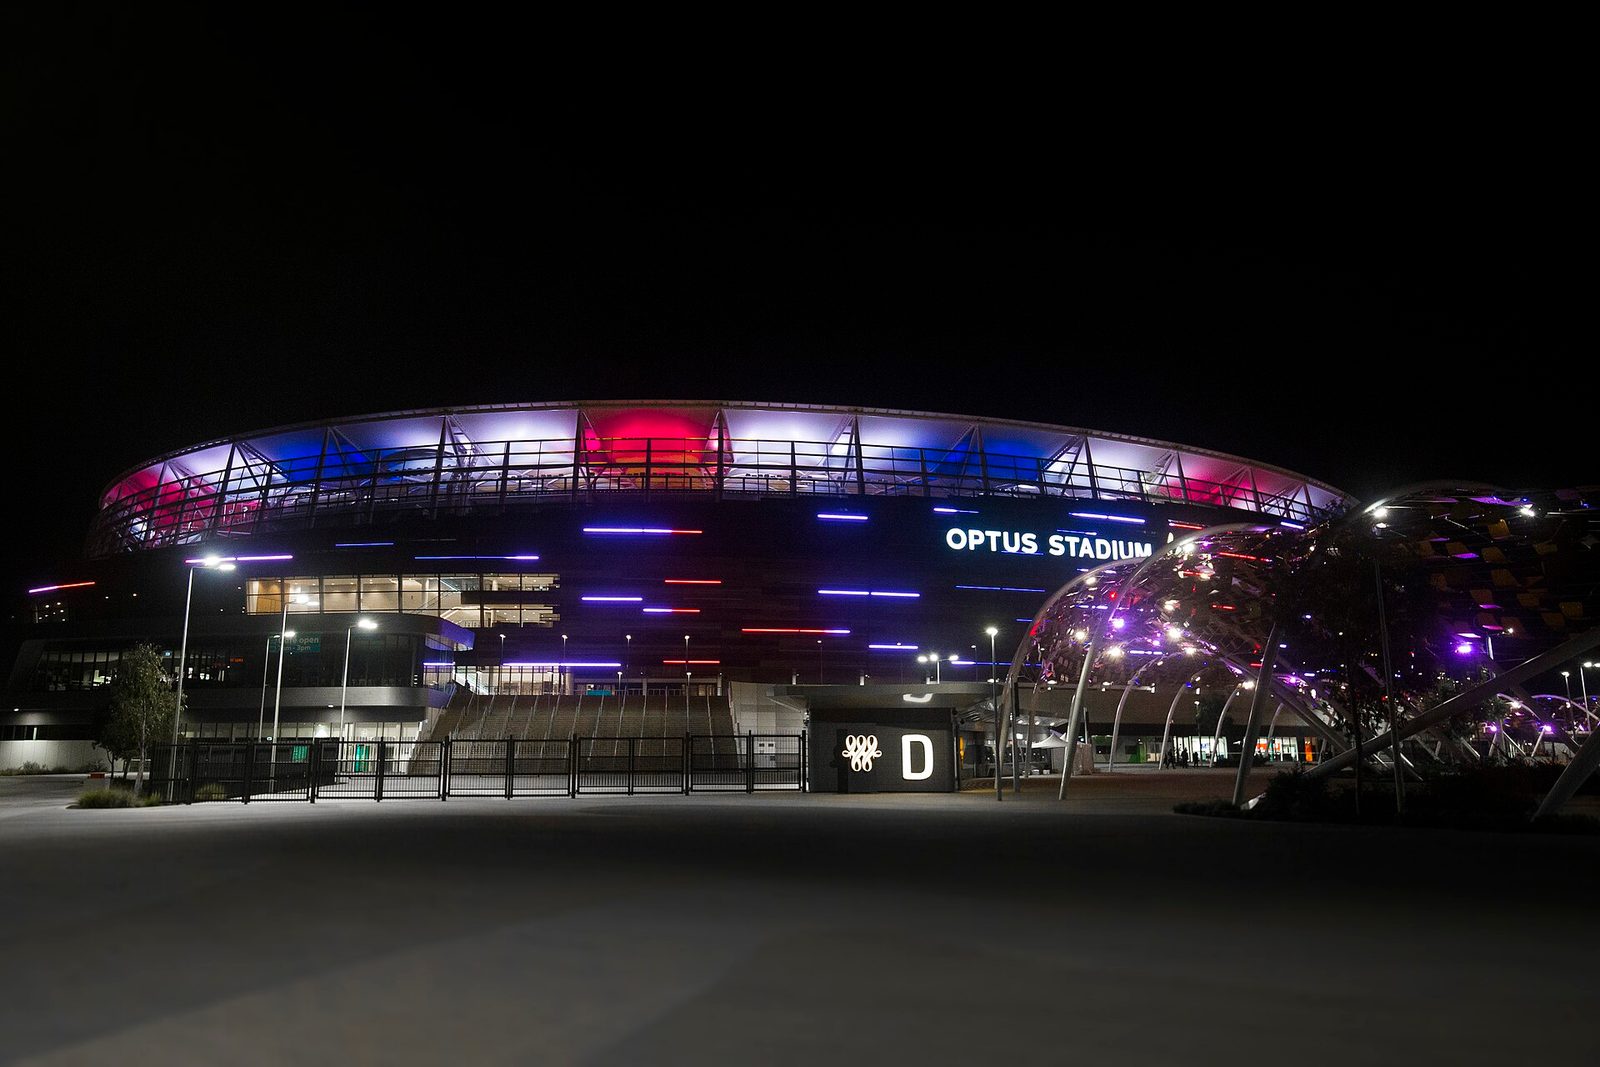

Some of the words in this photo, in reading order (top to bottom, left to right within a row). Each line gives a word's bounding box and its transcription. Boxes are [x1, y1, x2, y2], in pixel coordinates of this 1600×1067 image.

[946, 528, 1037, 553] OPTUS
[1049, 536, 1152, 560] STADIUM
[299, 637, 319, 646] open
[902, 734, 934, 780] D
